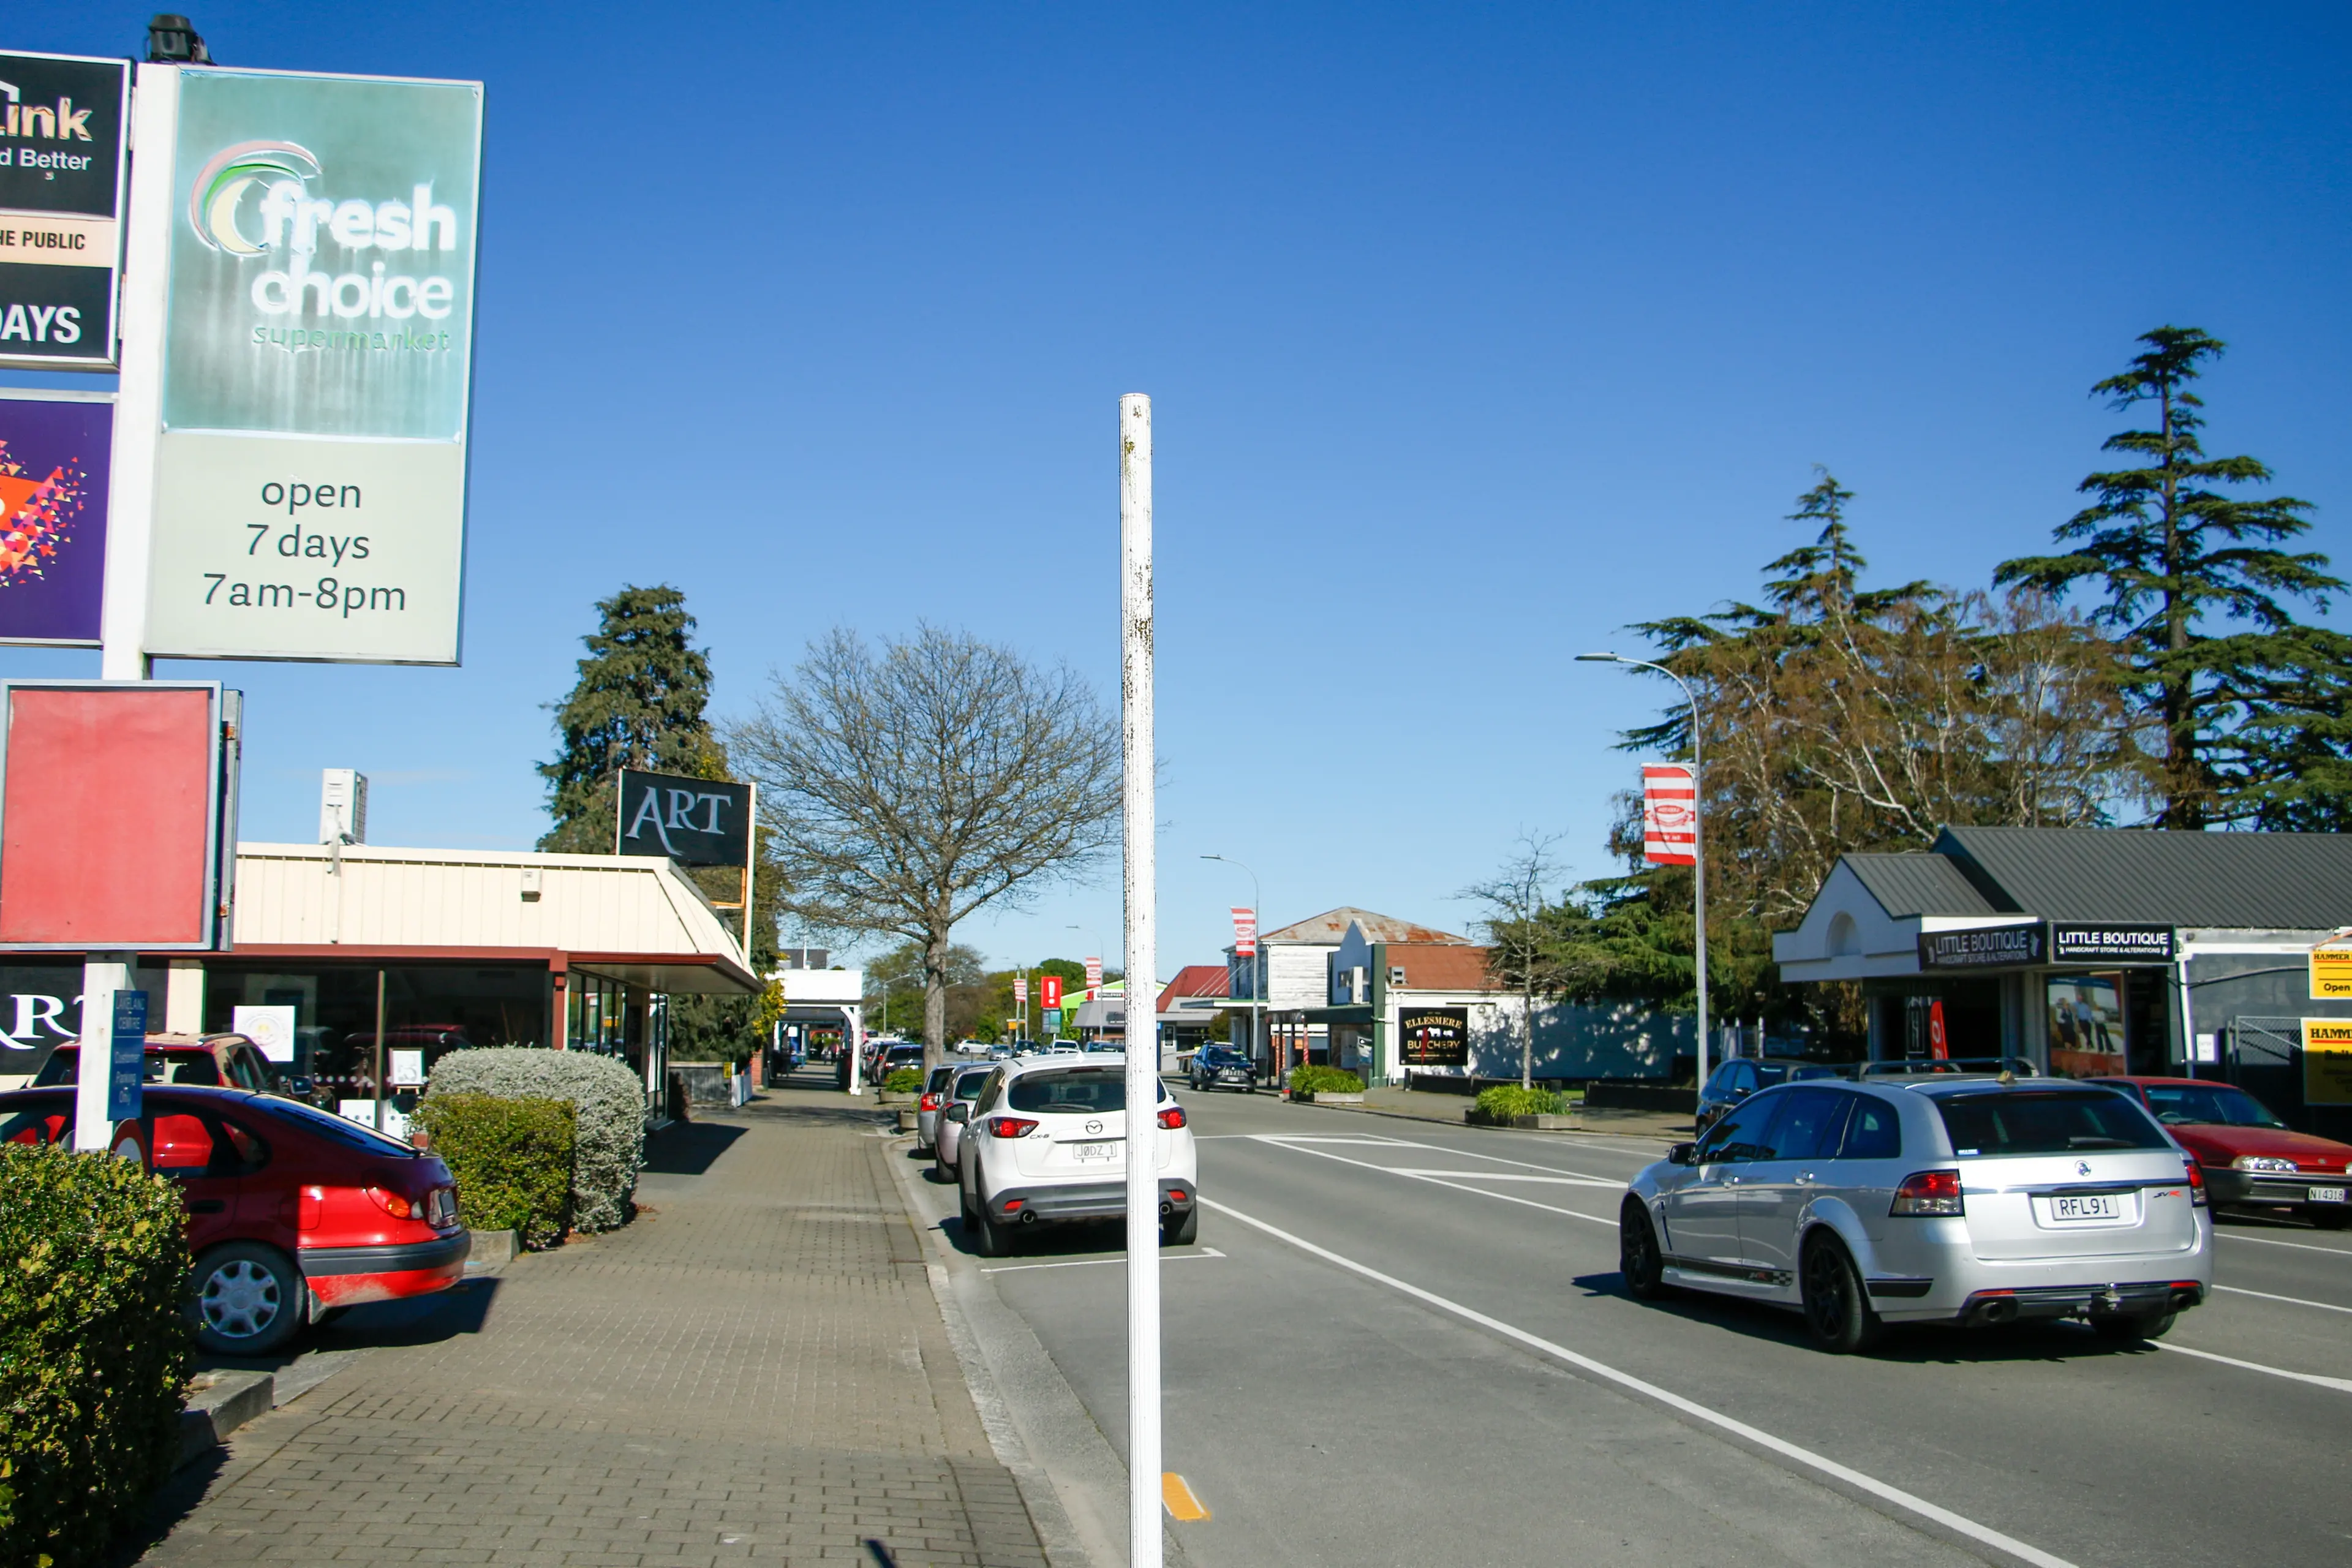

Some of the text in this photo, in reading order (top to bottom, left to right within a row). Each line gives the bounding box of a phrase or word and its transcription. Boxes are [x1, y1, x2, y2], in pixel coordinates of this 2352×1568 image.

[0, 97, 92, 141] ink
[19, 148, 91, 170] Better
[260, 179, 456, 251] fresh
[23, 231, 85, 250] PUBLIC
[251, 254, 453, 319] choice
[0, 304, 81, 344] AYS
[252, 325, 450, 353] supermarket
[262, 483, 361, 515] open
[247, 524, 369, 567] 7 days
[204, 573, 405, 619] 7am-8pm
[625, 786, 732, 856] ART
[1936, 930, 2027, 954] LITTLE BOUTIQUE
[2059, 932, 2168, 944] LITTLE BOUTIQUE
[1937, 954, 1967, 964] HANDCRAFT
[1968, 953, 1986, 963] STORE
[2324, 983, 2350, 992] Open
[1404, 1016, 1463, 1029] ELLESMERE
[1408, 1041, 1460, 1049] BUCHERY
[2059, 1198, 2109, 1215] RFL91
